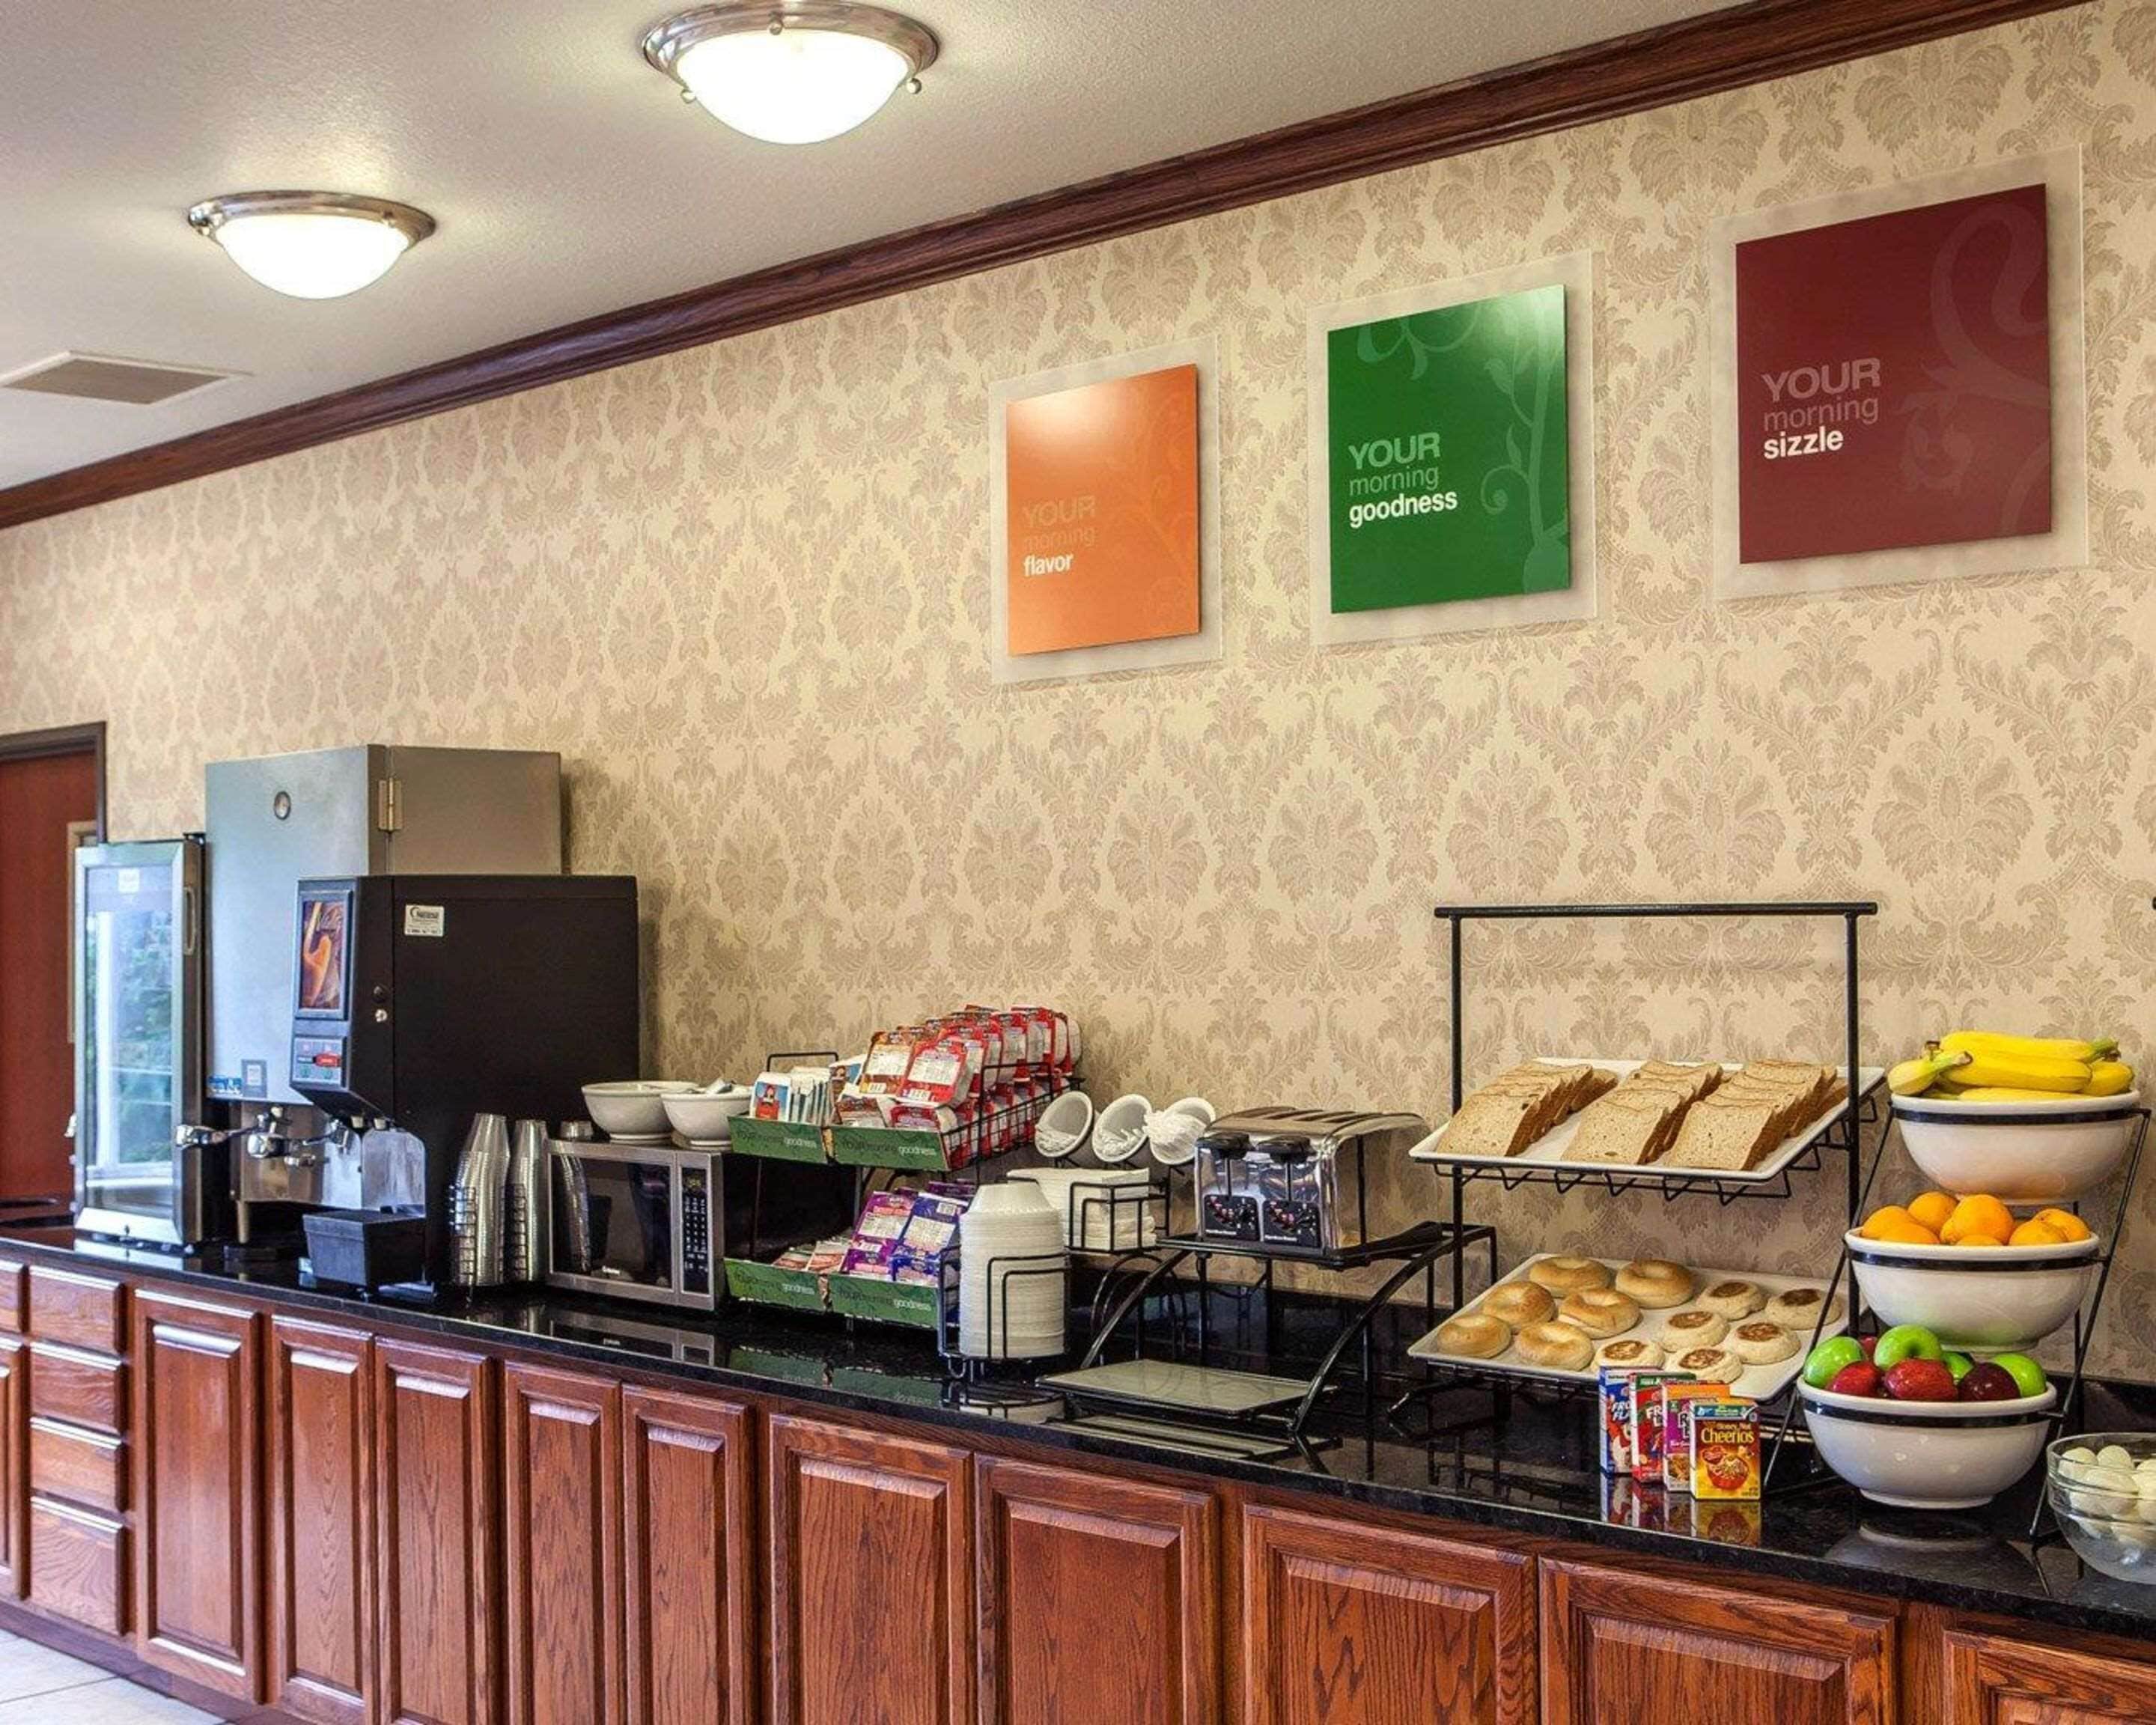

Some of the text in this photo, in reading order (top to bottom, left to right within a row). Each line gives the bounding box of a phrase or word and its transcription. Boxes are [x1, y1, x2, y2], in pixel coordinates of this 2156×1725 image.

[1761, 357, 1881, 403] YOUR
[1764, 396, 1879, 432] morning
[1348, 432, 1441, 470] YOUR
[1764, 425, 1844, 460] sizzle
[1349, 466, 1439, 496] morning
[1023, 495, 1095, 528] YOUR
[1349, 491, 1458, 529] goodness
[1023, 553, 1074, 577] flavor
[1701, 1428, 1755, 1444] Cheerios
